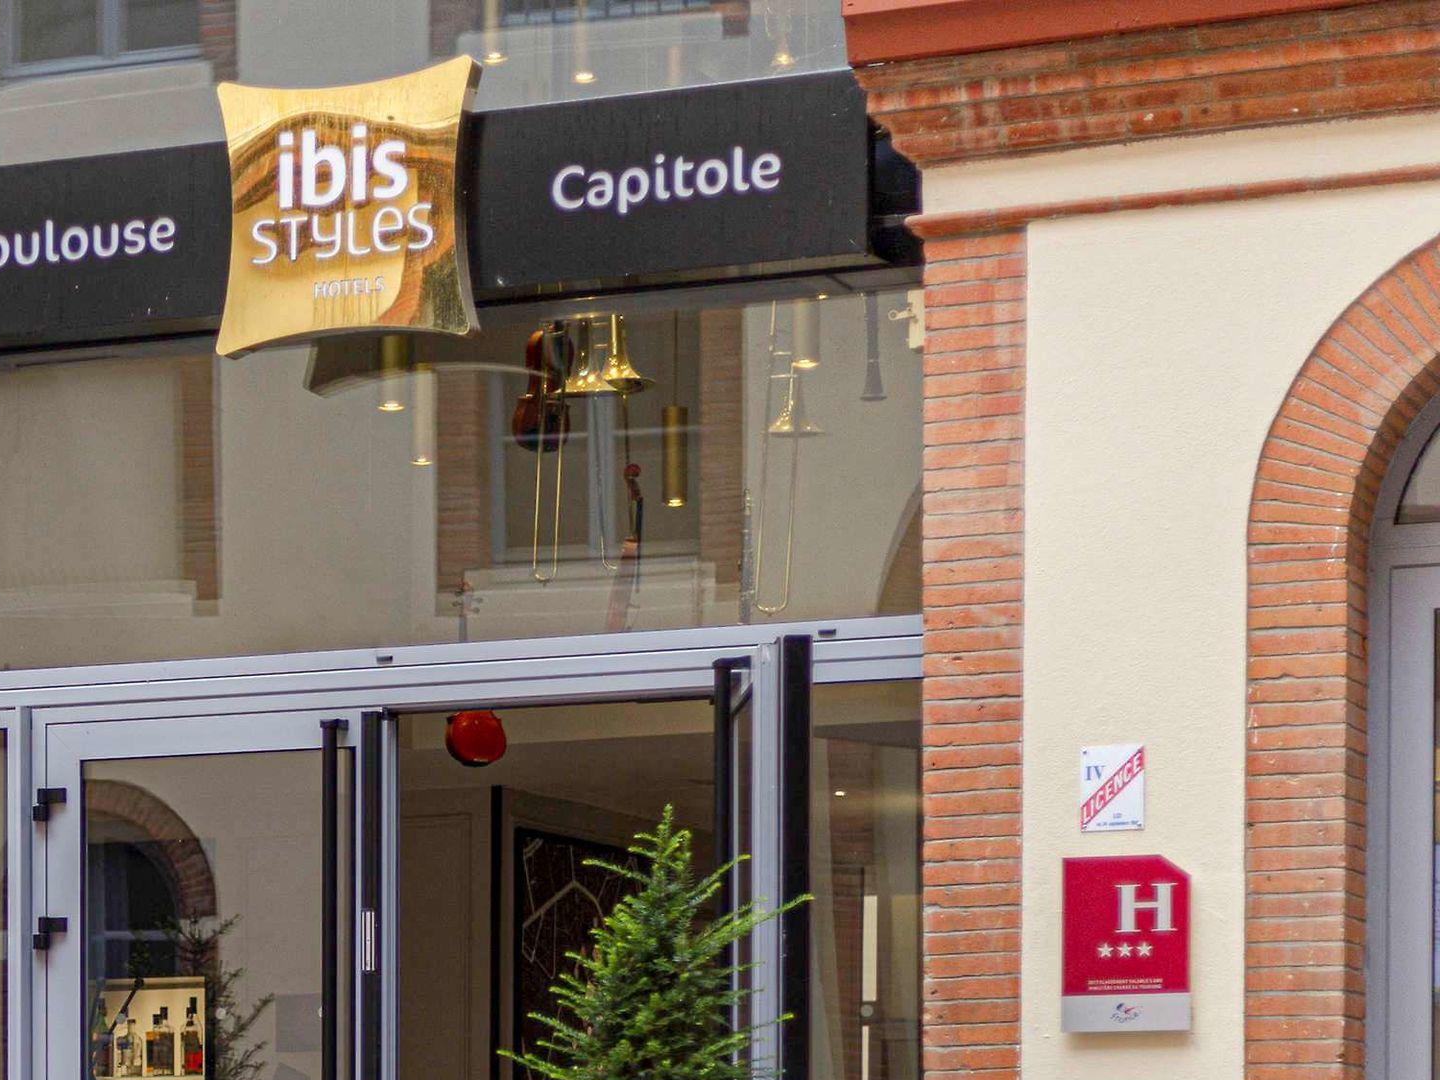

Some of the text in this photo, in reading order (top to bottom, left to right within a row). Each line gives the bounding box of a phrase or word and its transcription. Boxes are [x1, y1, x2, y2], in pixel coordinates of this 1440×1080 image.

[278, 123, 408, 209] ibis
[551, 146, 782, 214] Capitole
[314, 276, 385, 299] HOTELS
[1082, 751, 1143, 823] LICENCE
[1085, 765, 1106, 781] IV
[1115, 882, 1178, 933] H
